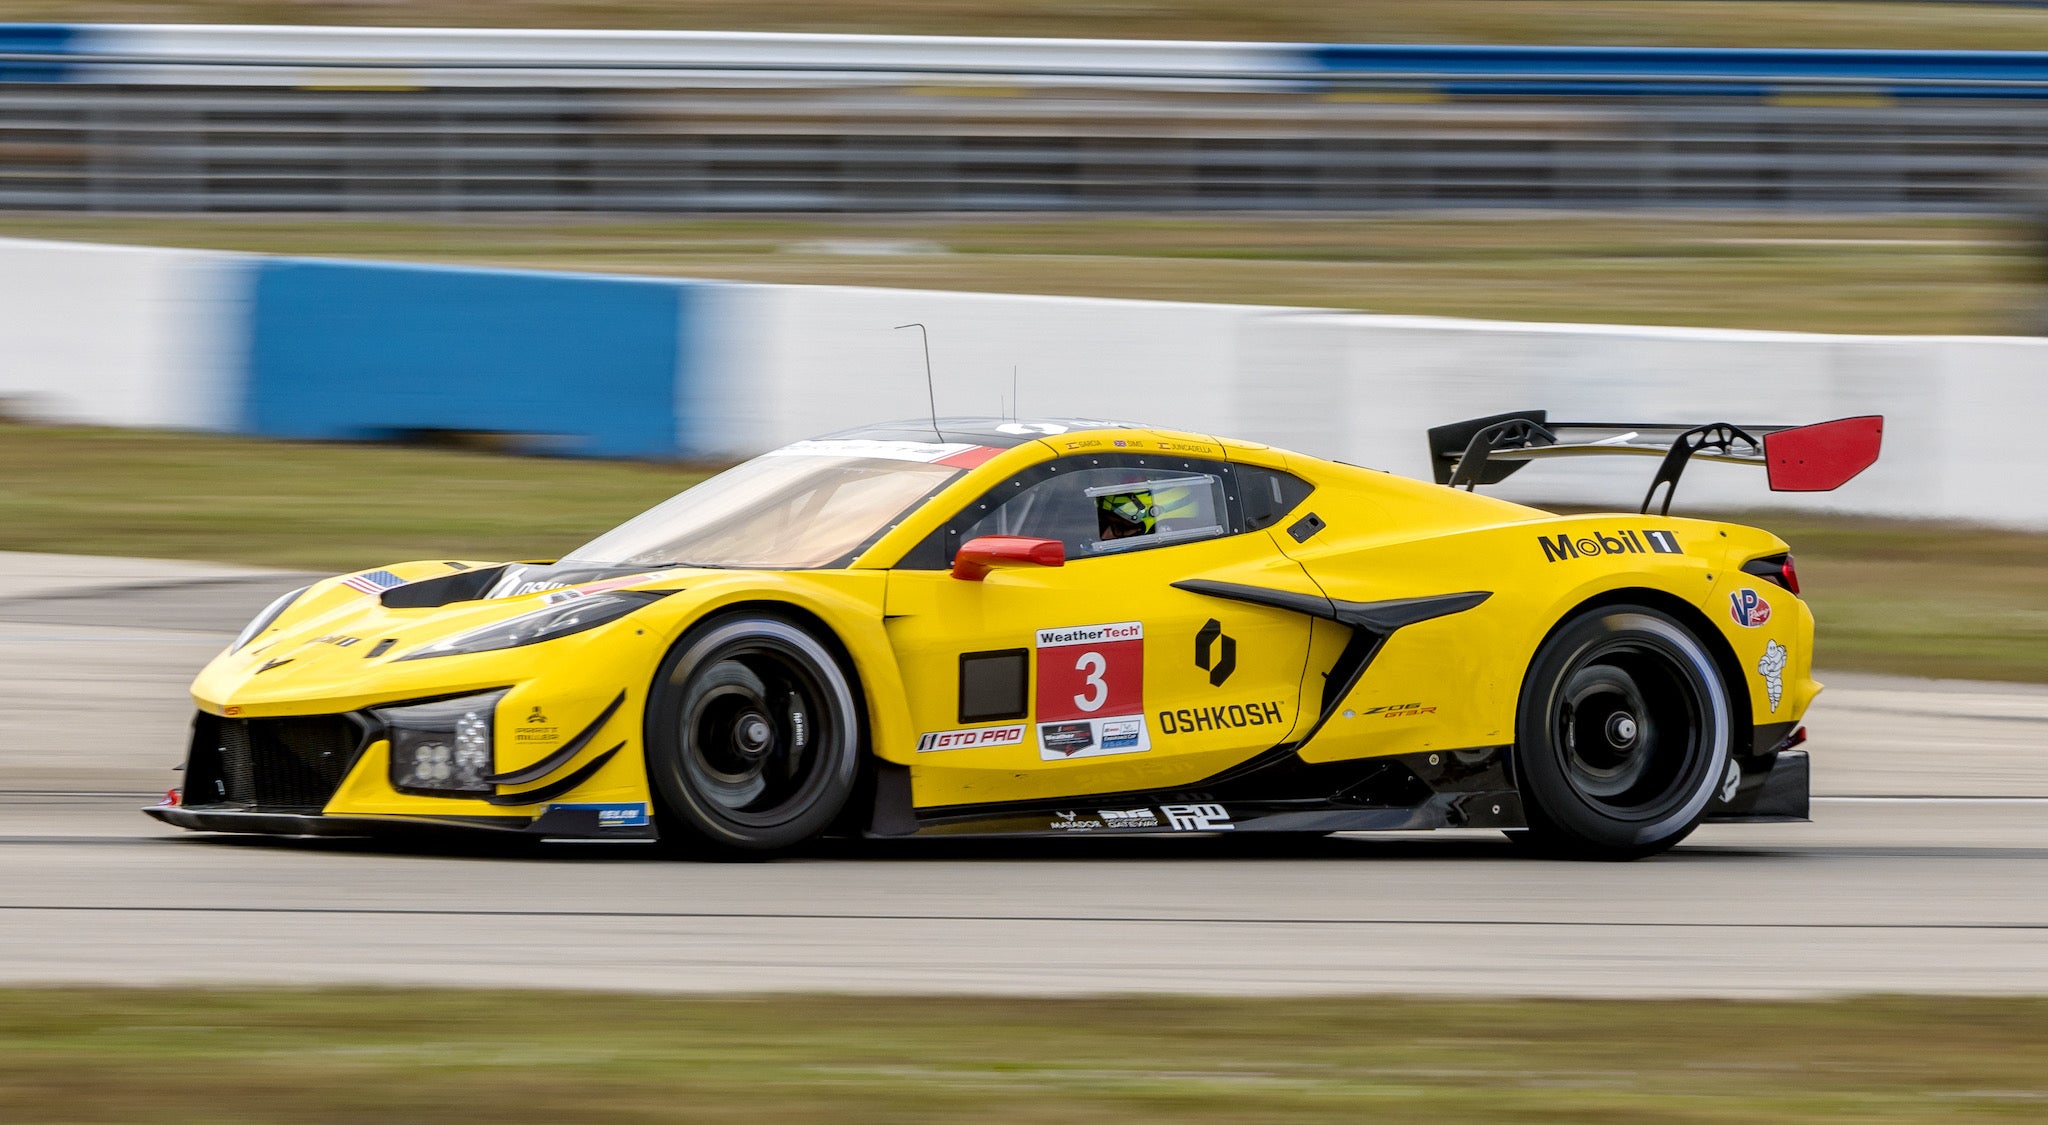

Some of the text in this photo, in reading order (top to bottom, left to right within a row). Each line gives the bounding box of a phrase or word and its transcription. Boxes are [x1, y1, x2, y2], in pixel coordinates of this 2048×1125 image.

[1537, 530, 1646, 563] Mobil
[1730, 589, 1758, 627] VP
[1040, 625, 1139, 643] WeatherTech
[1073, 651, 1108, 712] 3
[1158, 701, 1283, 735] OSHKOSH
[1362, 702, 1421, 715] Z06
[937, 728, 1021, 747] GTD PRO
